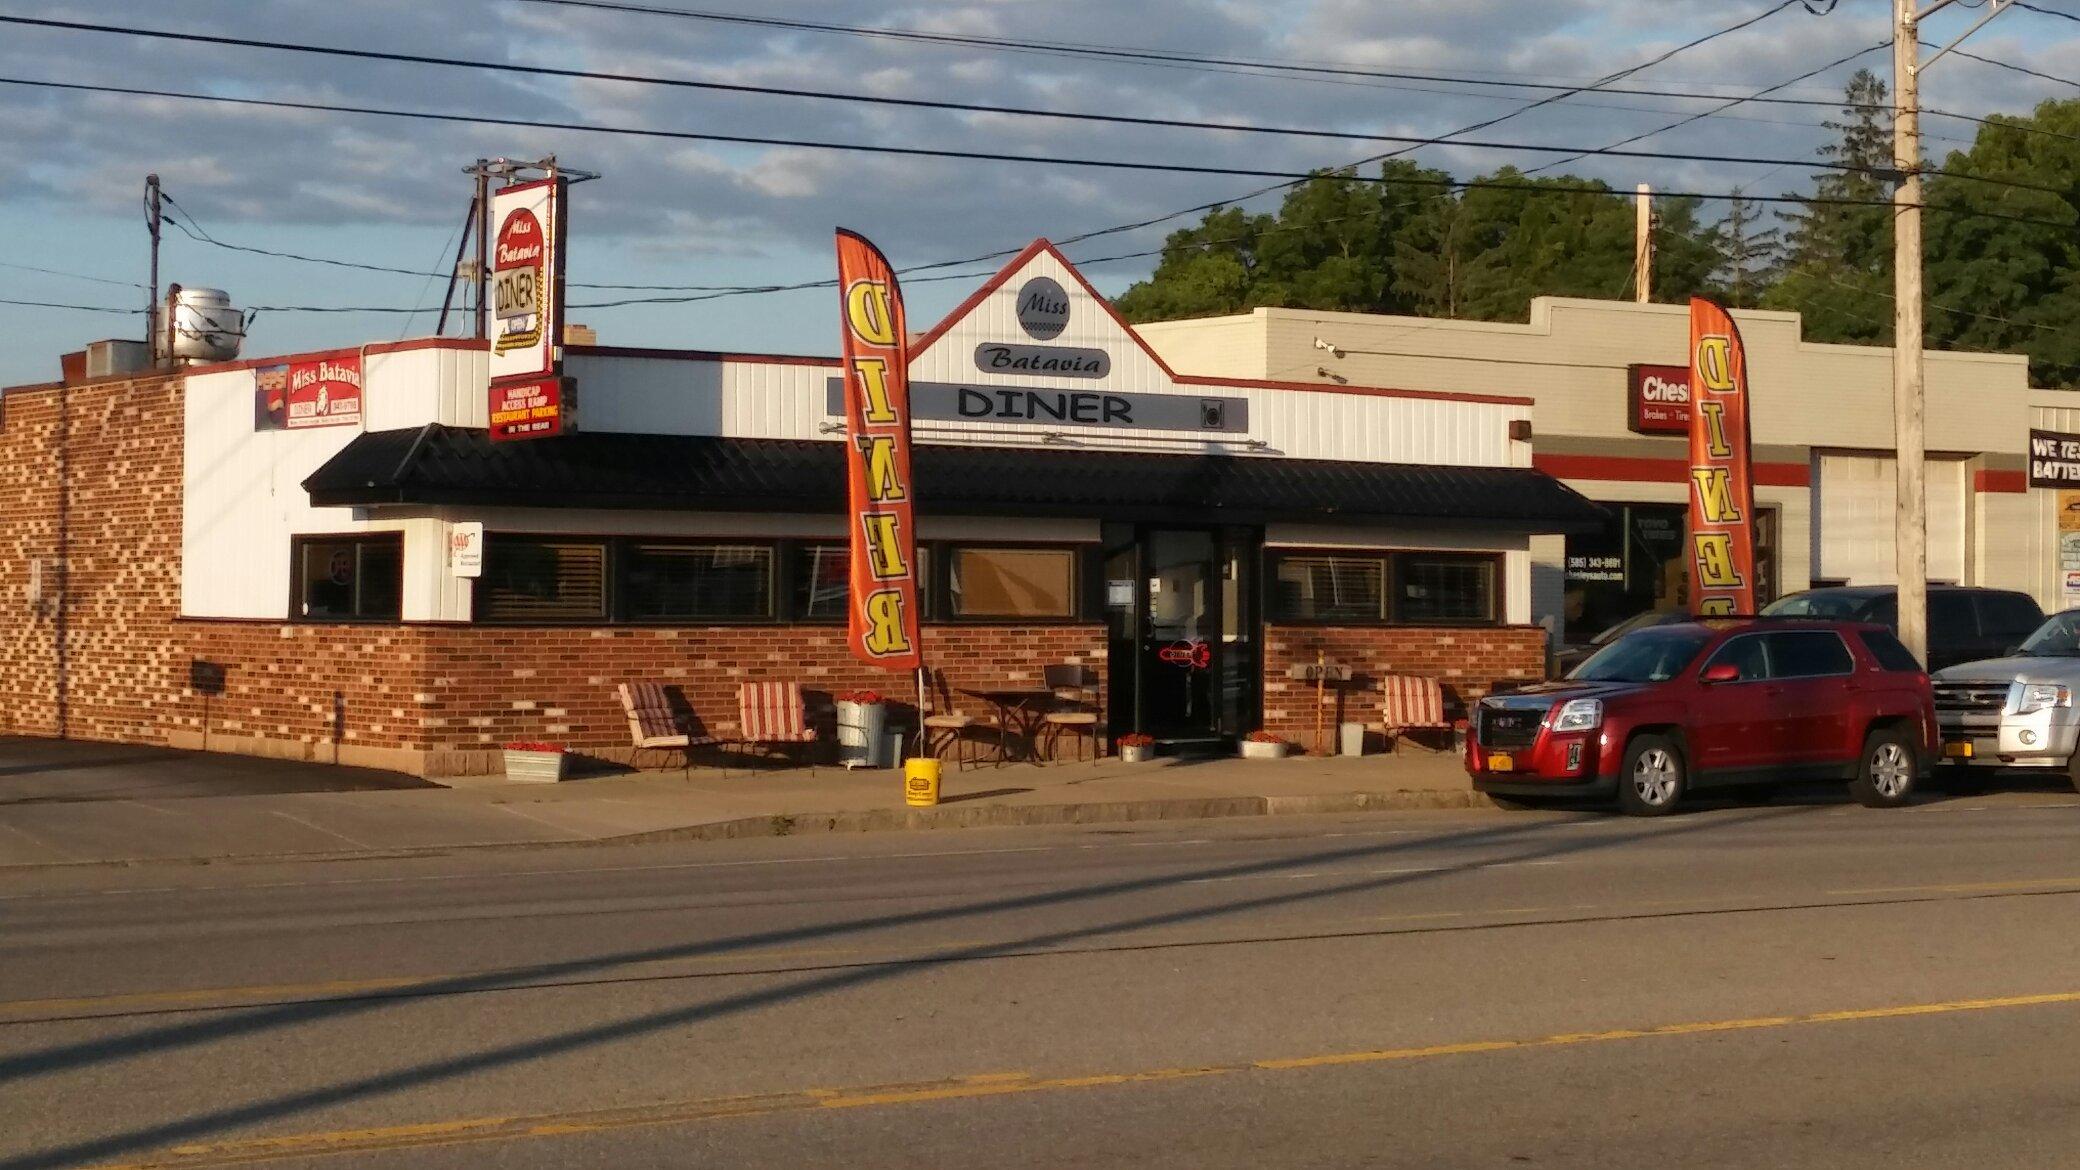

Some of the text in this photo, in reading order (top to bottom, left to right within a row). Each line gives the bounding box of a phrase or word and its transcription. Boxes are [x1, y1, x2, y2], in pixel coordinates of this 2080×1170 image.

[509, 219, 531, 240] Miss
[499, 243, 540, 263] Batavia
[497, 273, 533, 311] DINER
[1021, 293, 1066, 316] Miss
[984, 347, 1100, 373] Batavia
[292, 369, 316, 393] Miss
[958, 388, 1134, 424] DINER
[2032, 438, 2080, 459] WE TE
